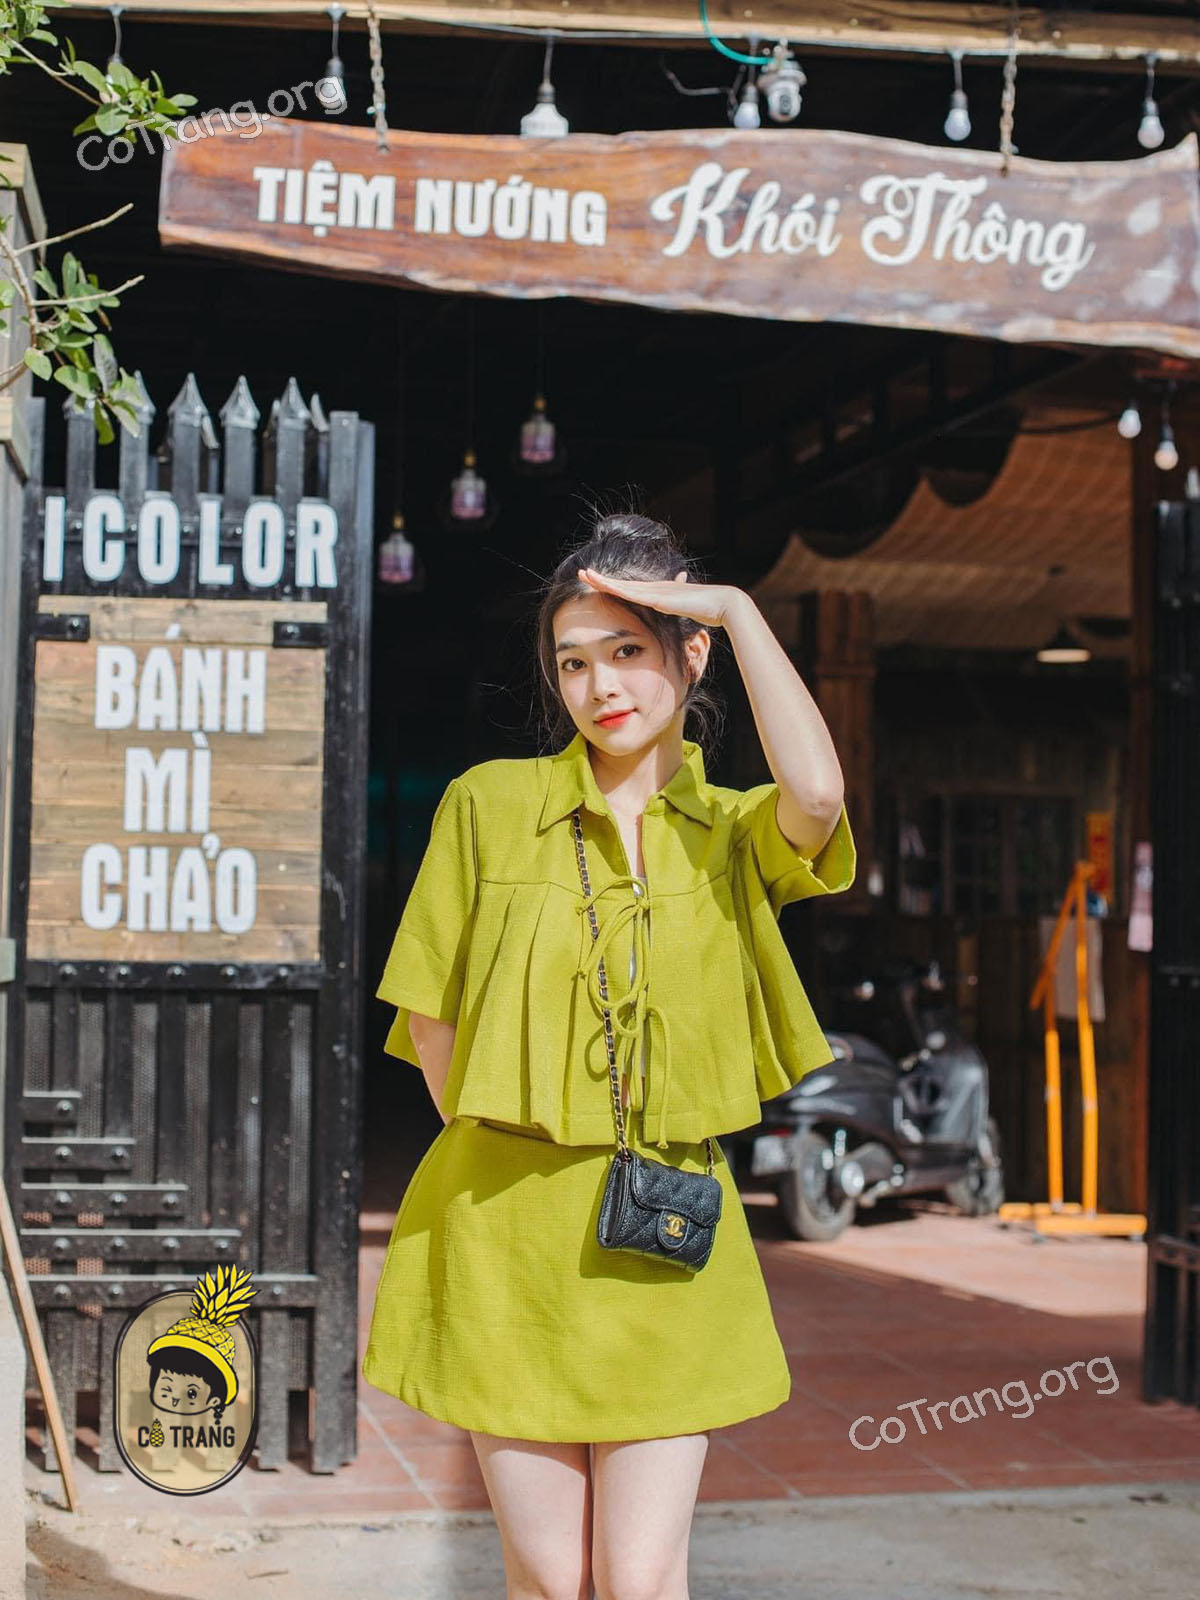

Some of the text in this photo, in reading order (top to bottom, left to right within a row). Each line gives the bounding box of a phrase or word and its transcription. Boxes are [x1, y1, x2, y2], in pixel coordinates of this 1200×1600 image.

[253, 160, 1096, 291] TIỆM NƯỚNG Khói Thông
[94, 623, 267, 734] BÁNH
[123, 730, 211, 833] MÌ
[81, 832, 257, 934] CHẢO
